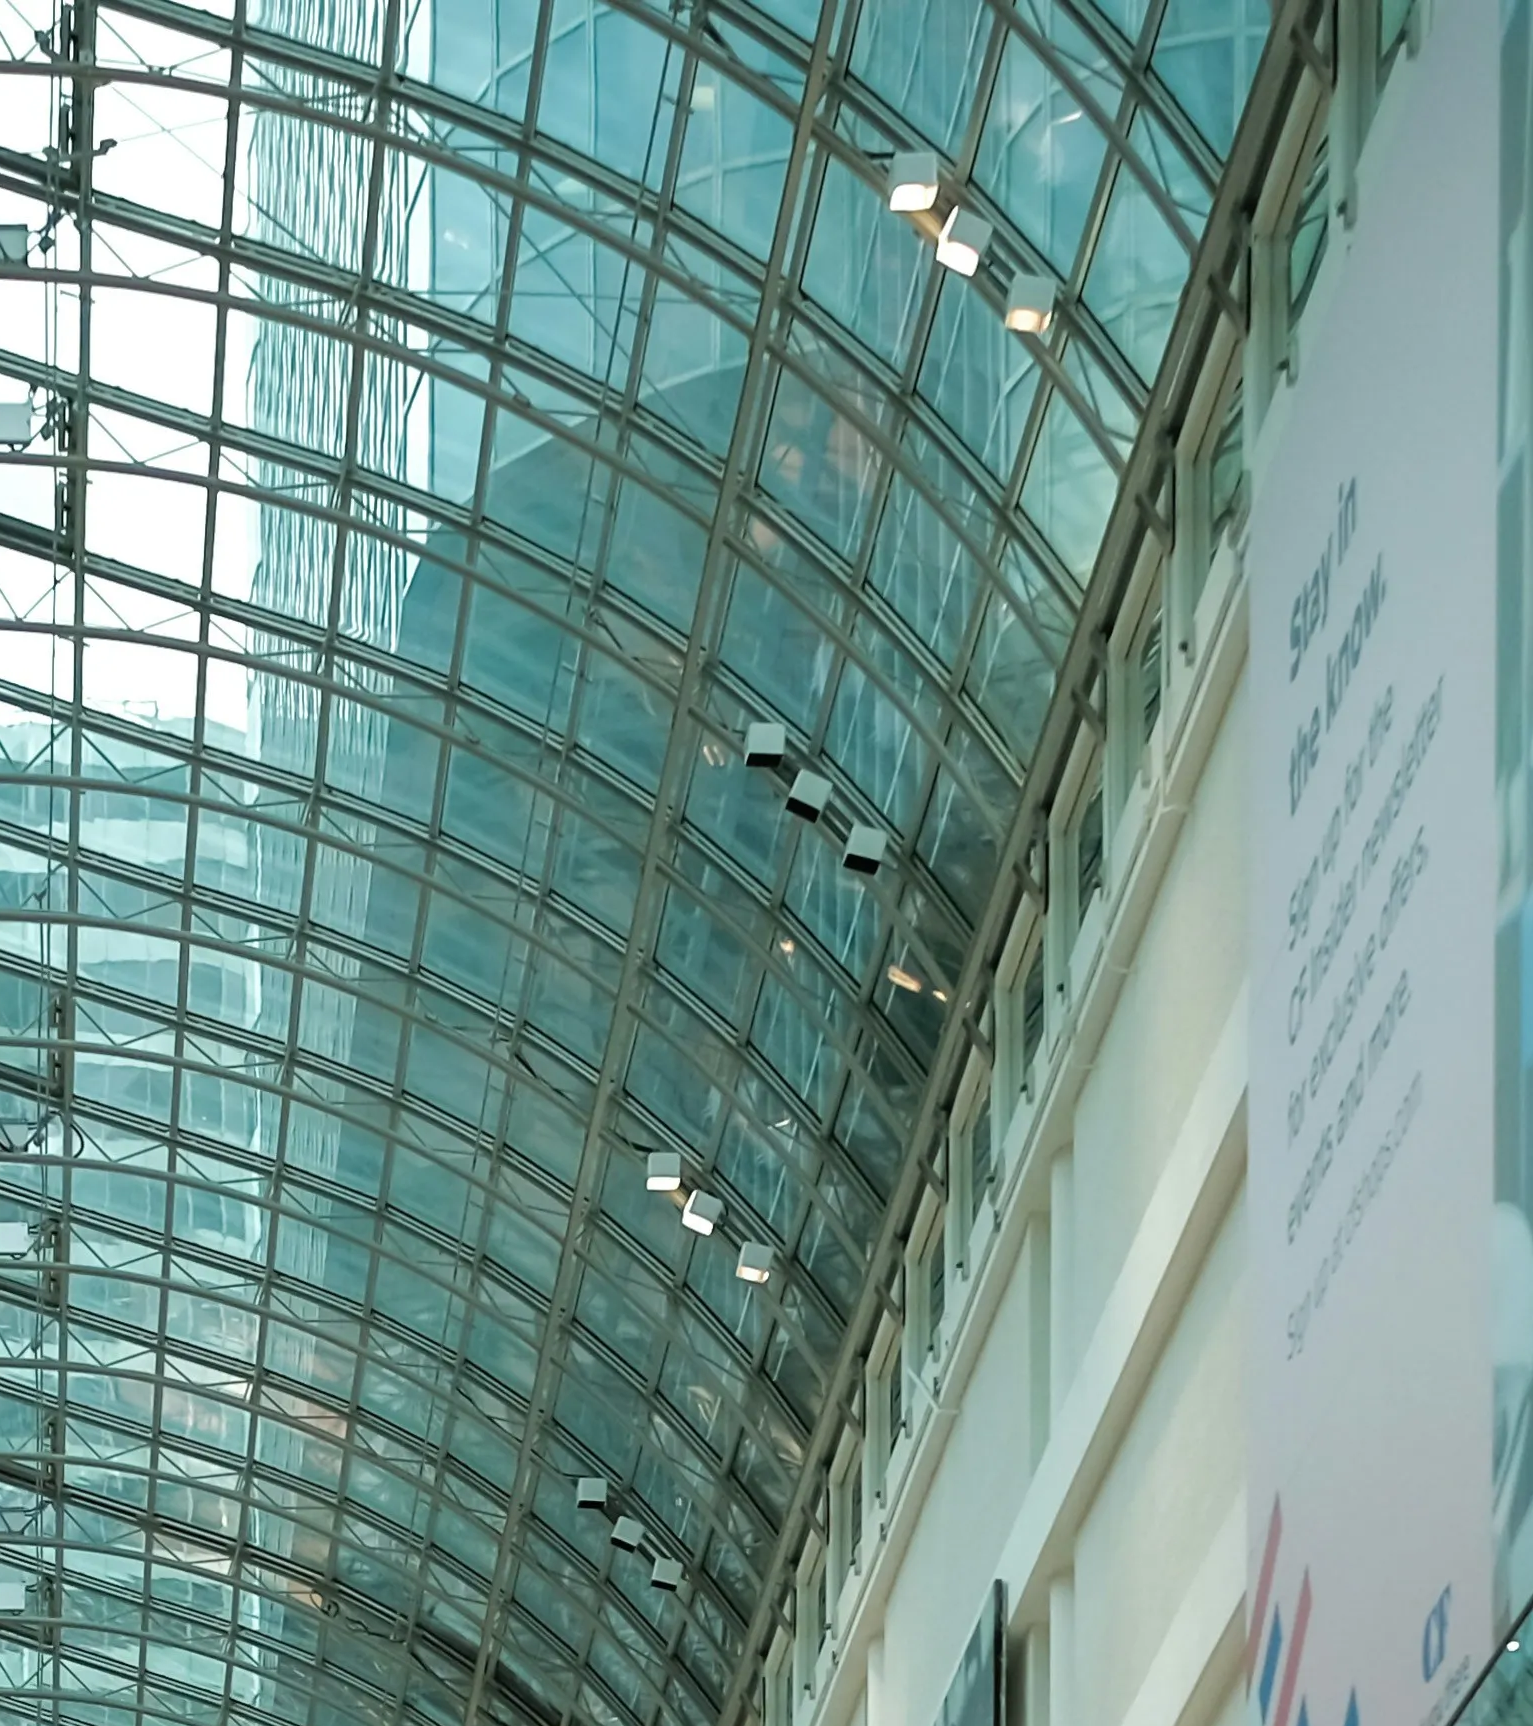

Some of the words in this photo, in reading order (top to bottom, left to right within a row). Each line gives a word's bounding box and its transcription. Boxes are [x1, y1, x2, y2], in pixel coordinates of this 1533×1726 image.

[1288, 704, 1320, 817] the
[1325, 548, 1387, 734] know.
[1289, 530, 1332, 683] Stay
[1337, 474, 1357, 566] in
